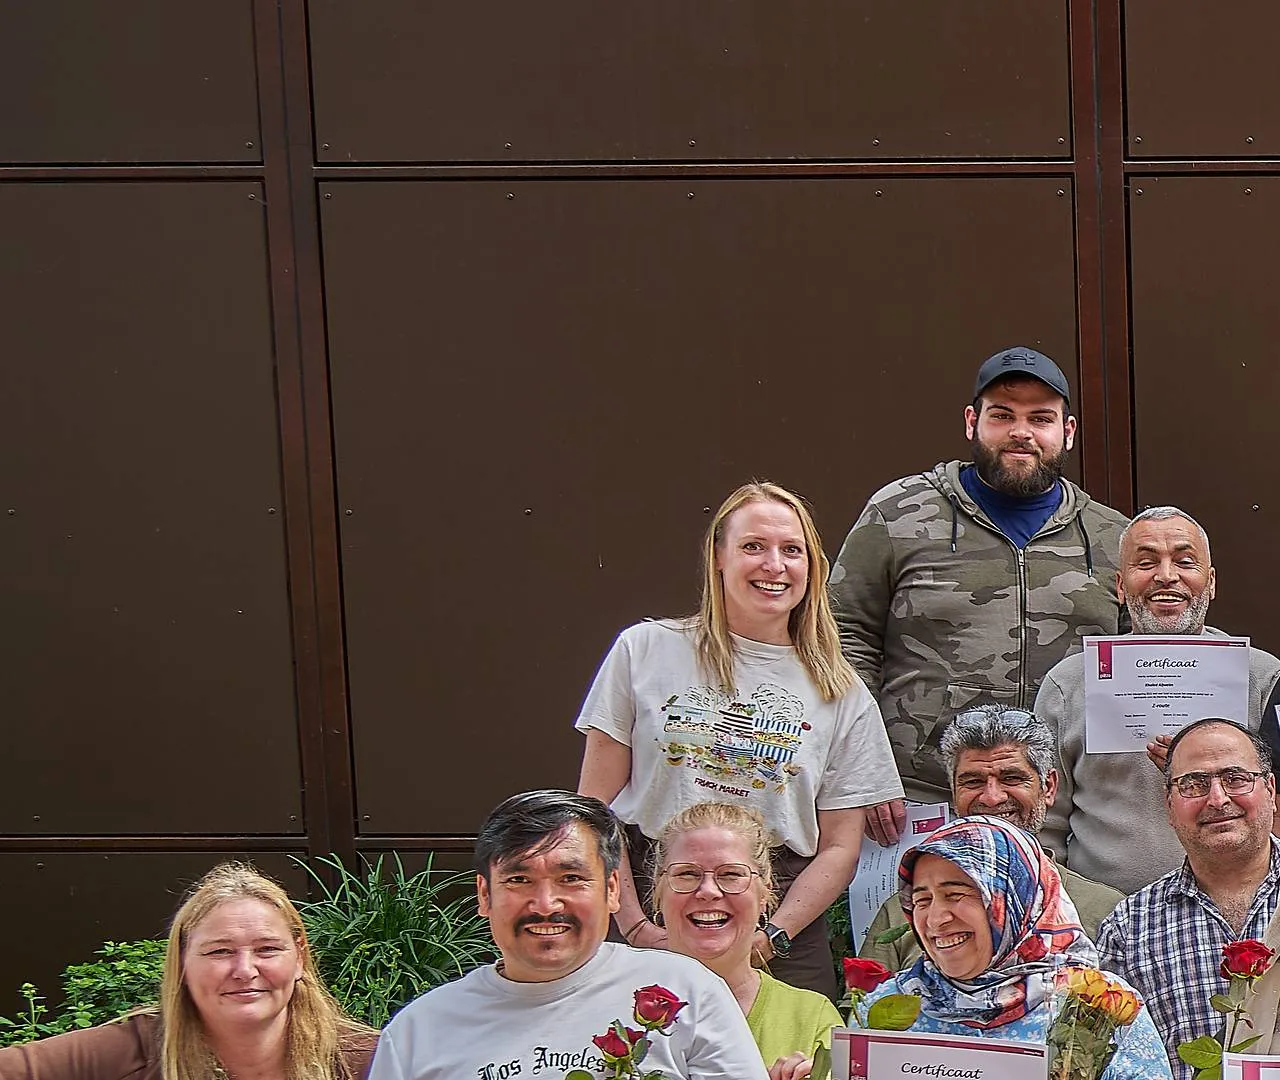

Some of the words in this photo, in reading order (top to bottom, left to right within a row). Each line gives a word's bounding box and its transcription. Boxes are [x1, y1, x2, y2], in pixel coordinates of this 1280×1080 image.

[1135, 657, 1199, 669] Certificaat
[719, 784, 750, 797] MARKET
[532, 1046, 606, 1075] Angeles
[900, 1062, 983, 1080] Certificaat
